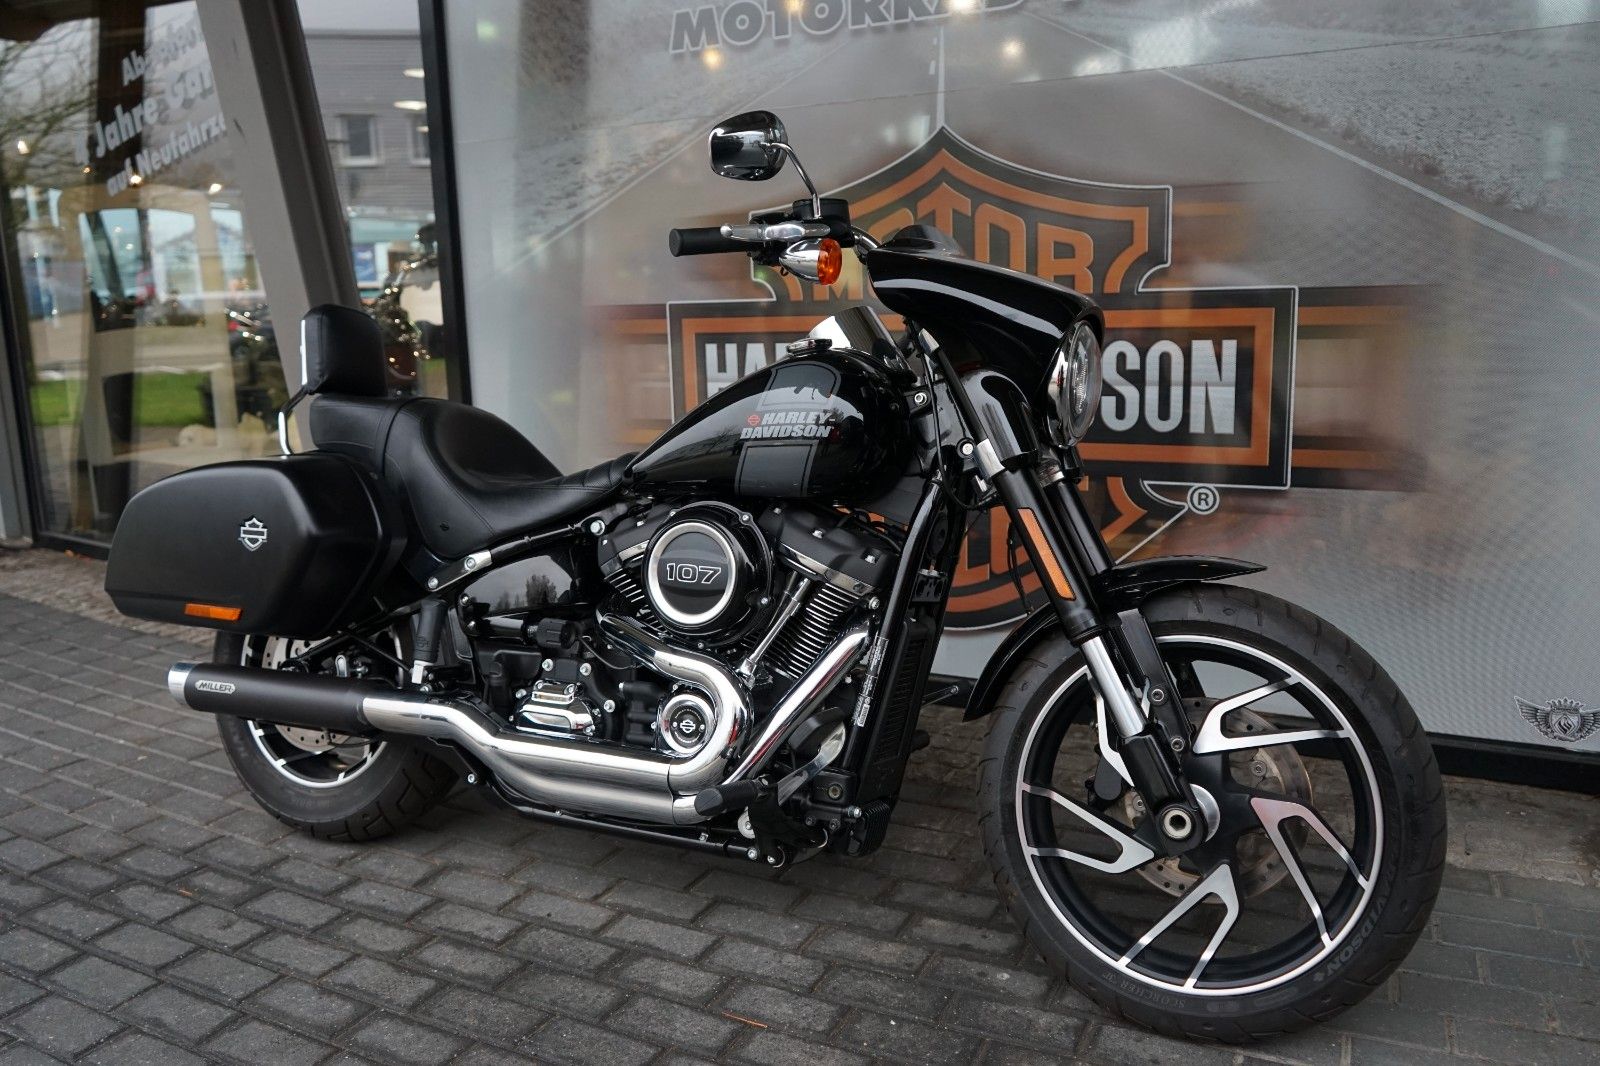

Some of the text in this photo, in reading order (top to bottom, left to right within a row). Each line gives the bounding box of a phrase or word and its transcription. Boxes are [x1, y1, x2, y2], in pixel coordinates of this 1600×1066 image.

[761, 411, 836, 425] HARLEY-
[740, 424, 832, 439] DAVIDSON
[667, 563, 721, 584] 107
[198, 682, 232, 692] MILLER
